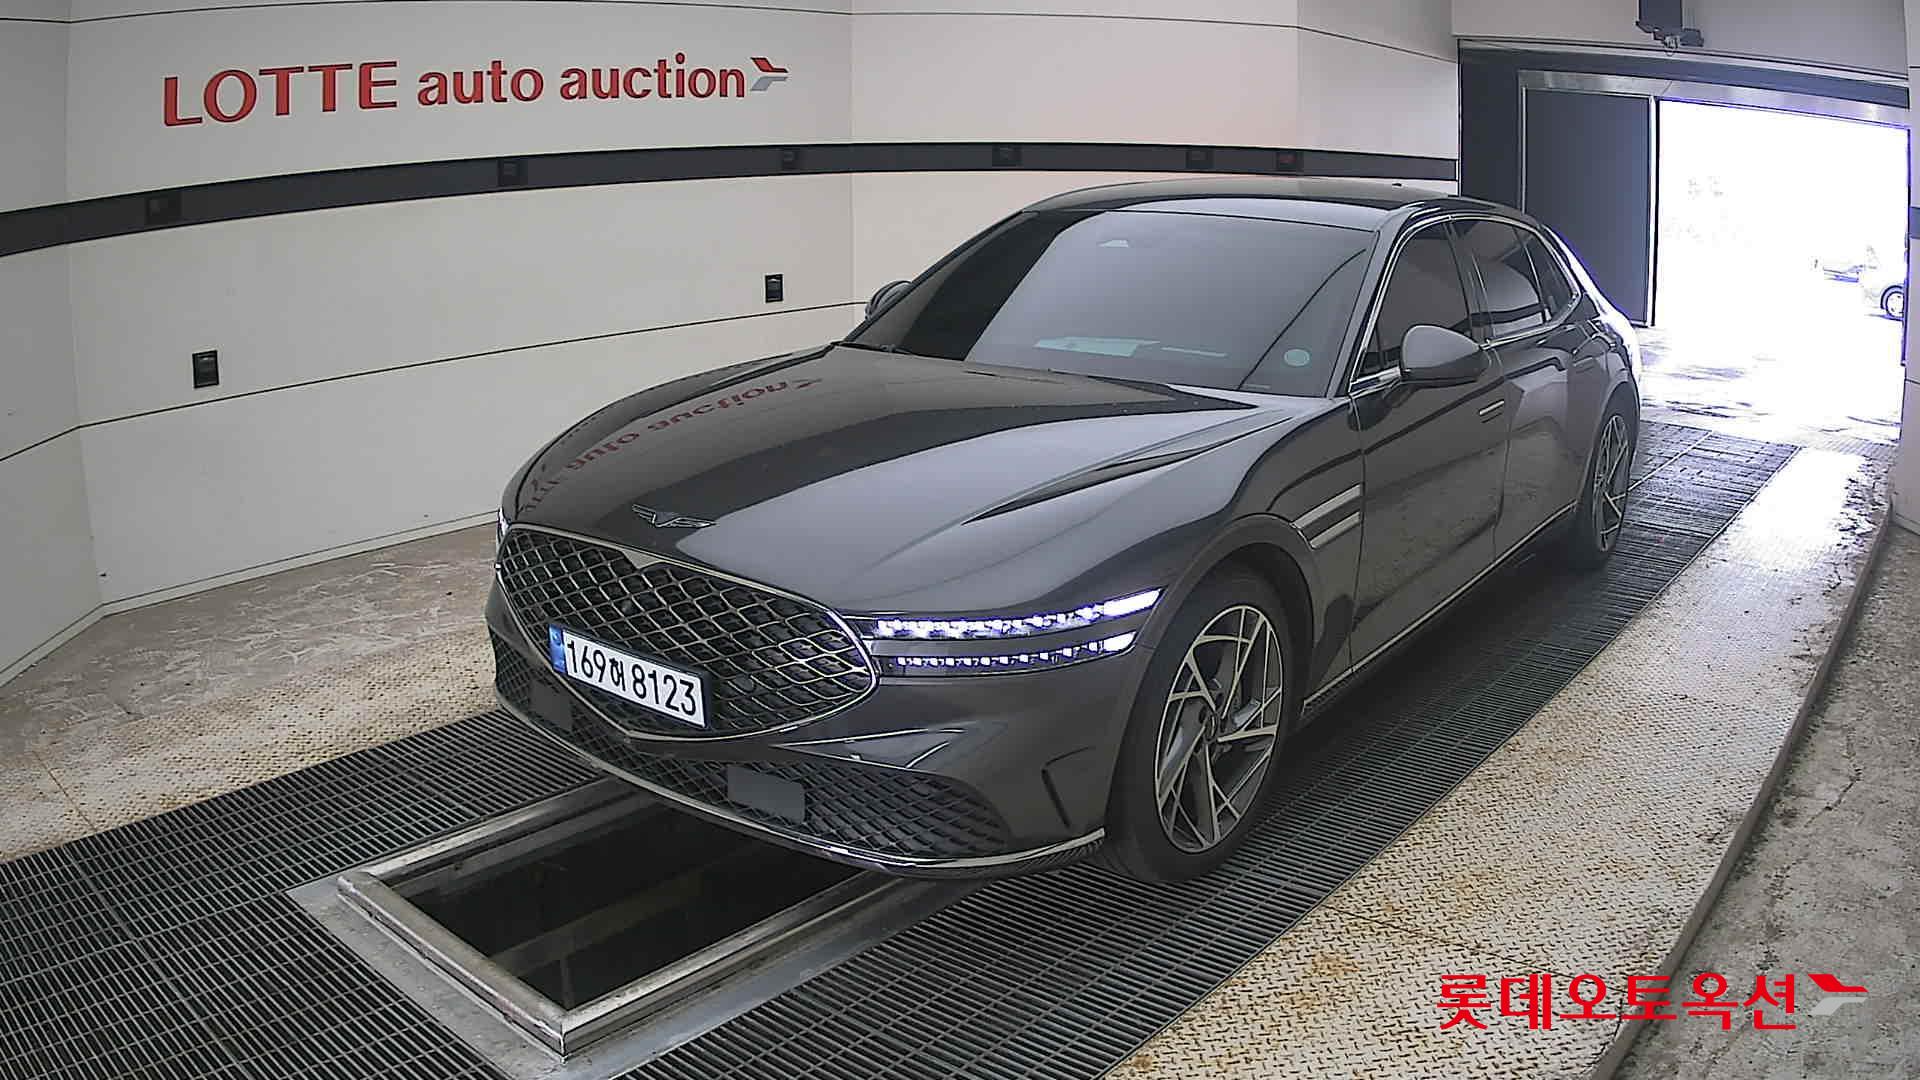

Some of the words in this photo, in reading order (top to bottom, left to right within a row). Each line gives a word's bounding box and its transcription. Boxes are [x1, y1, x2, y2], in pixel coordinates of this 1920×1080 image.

[162, 61, 397, 127] LOTTE
[417, 60, 544, 106] auto
[559, 52, 745, 99] auction
